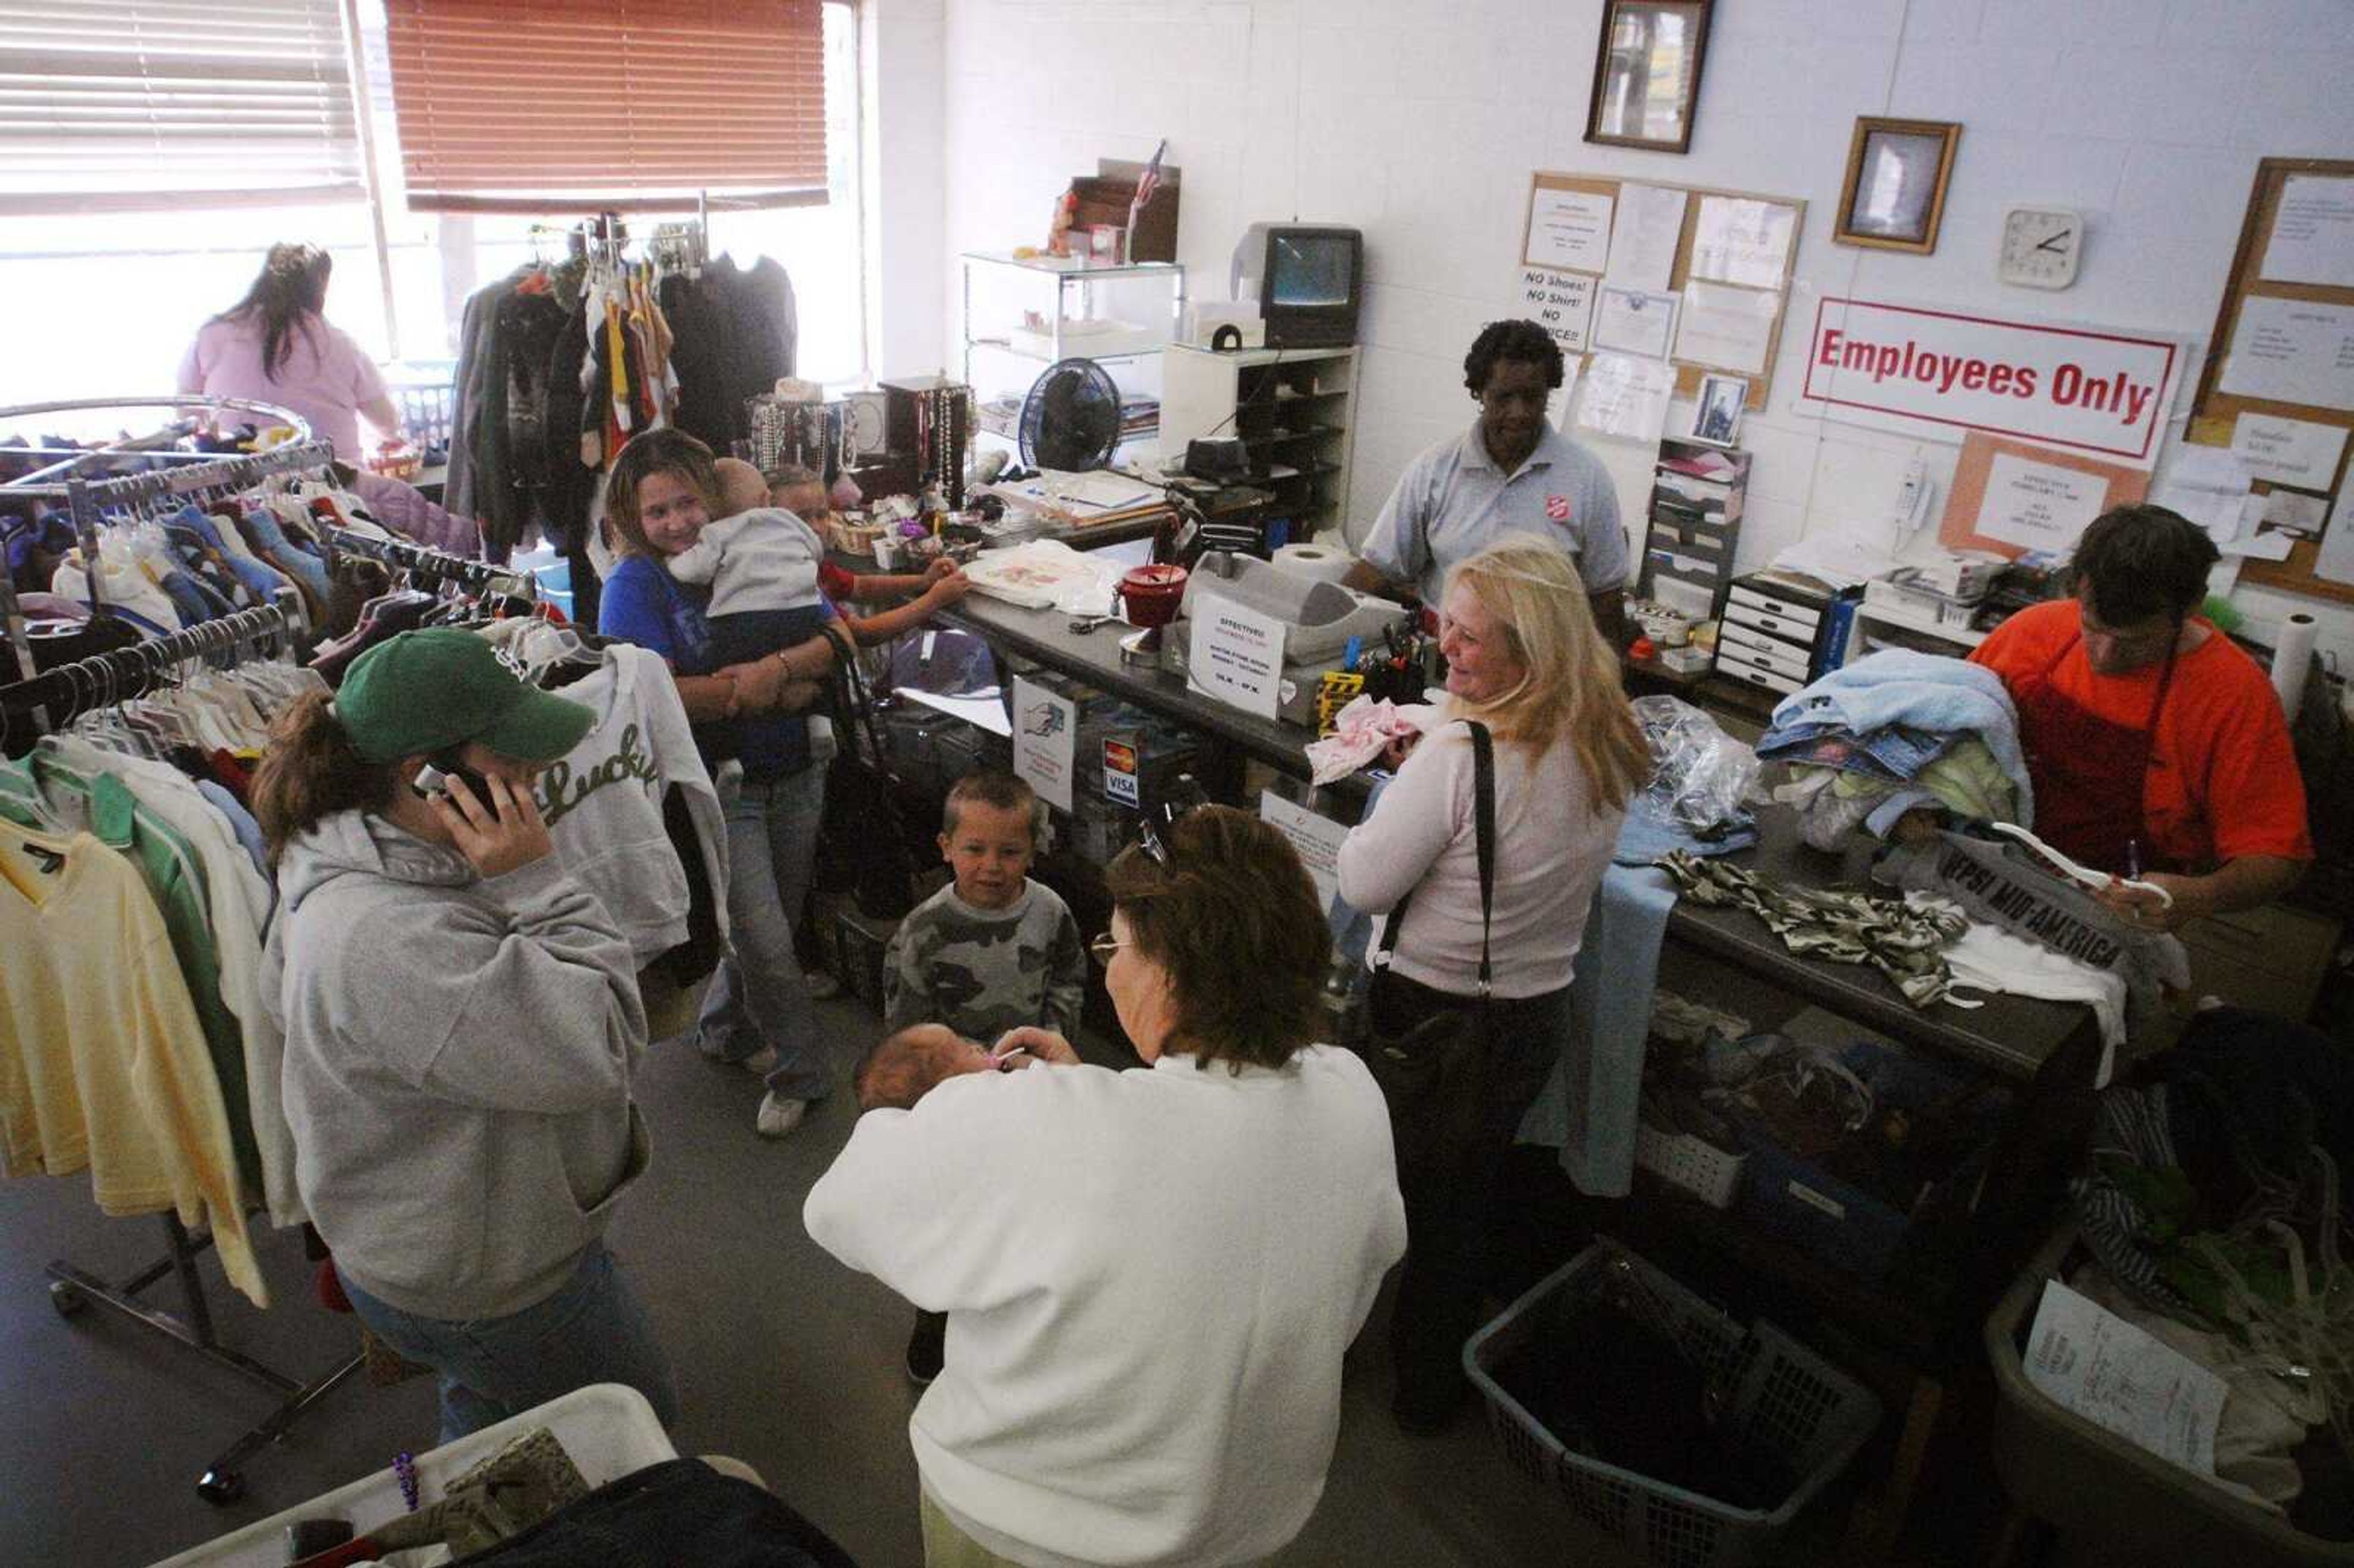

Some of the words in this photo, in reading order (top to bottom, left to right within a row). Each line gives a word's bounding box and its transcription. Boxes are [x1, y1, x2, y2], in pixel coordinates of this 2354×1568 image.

[1525, 272, 1544, 284] NO
[1526, 290, 1545, 302] NO
[1542, 308, 1561, 321] NO
[1818, 329, 2038, 399] Employees
[2051, 363, 2152, 425] Only
[1110, 776, 1135, 794] VISA
